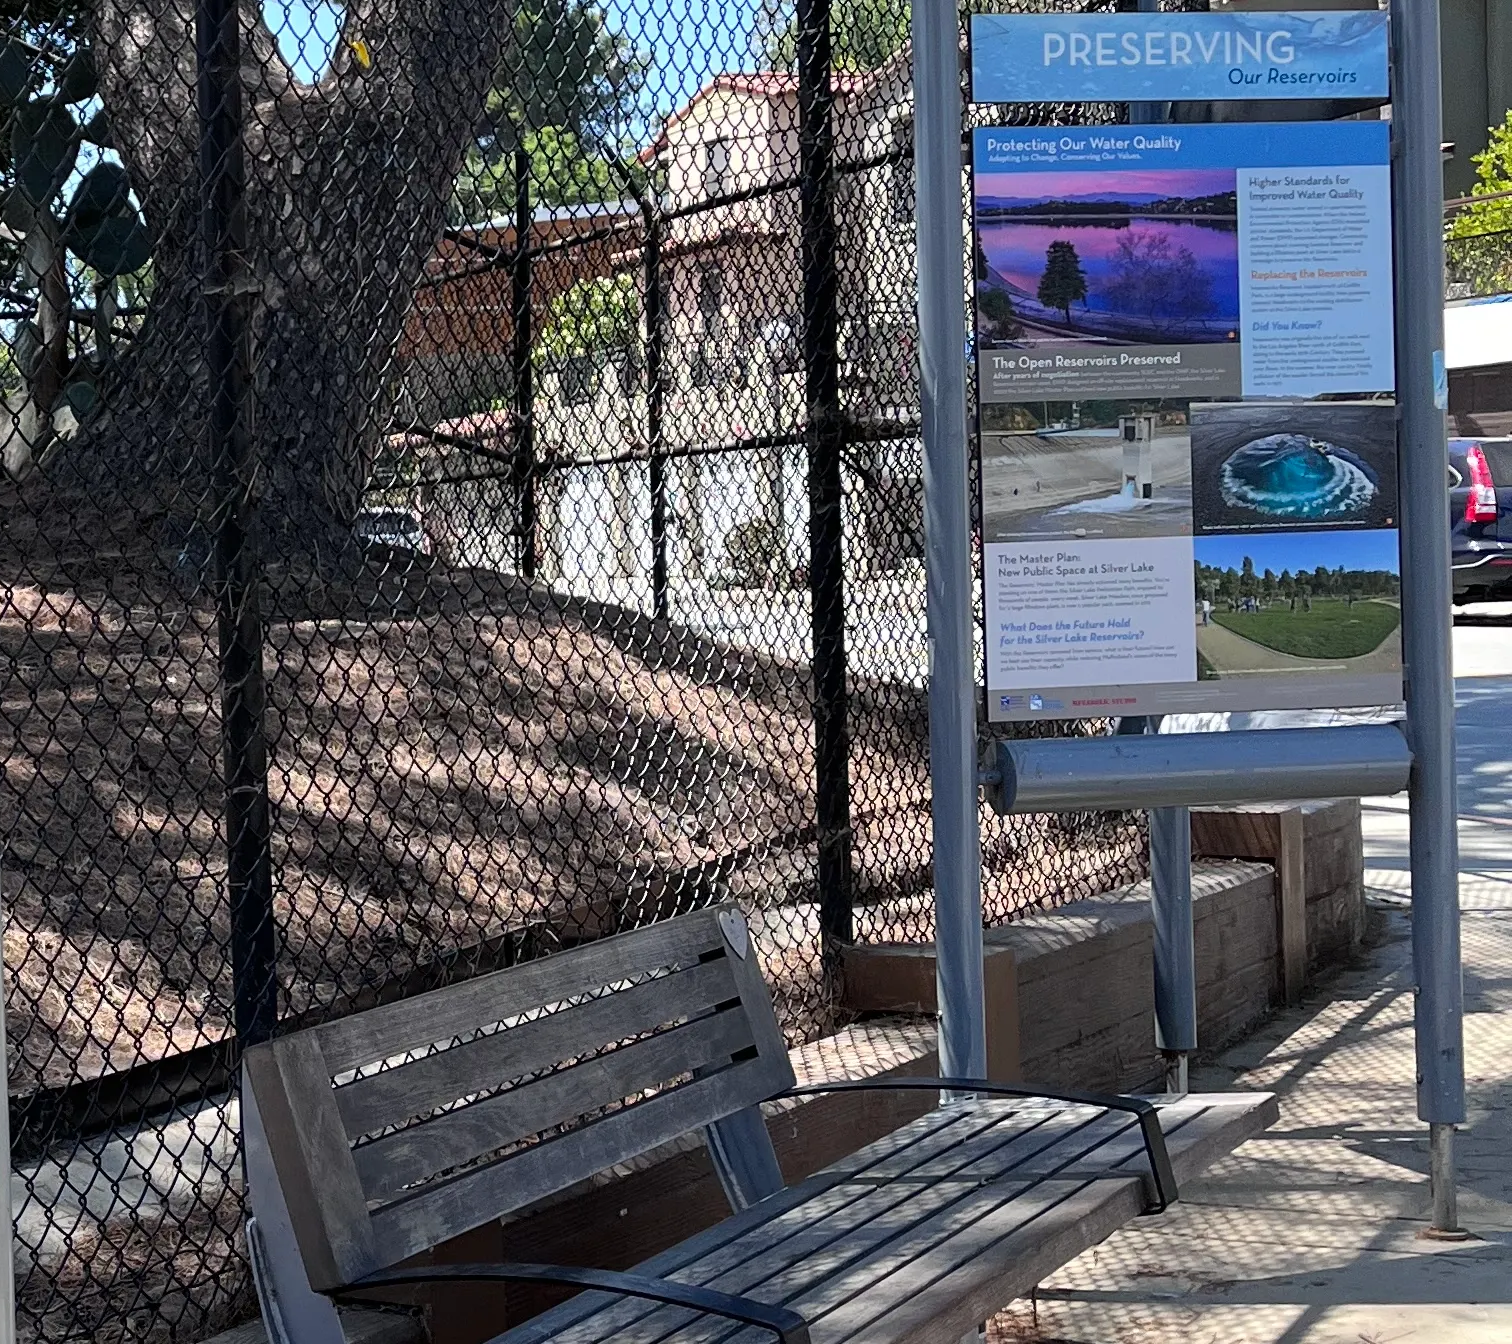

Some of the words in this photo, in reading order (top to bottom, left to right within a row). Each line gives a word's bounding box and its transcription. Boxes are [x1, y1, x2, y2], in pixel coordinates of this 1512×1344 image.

[1043, 30, 1296, 67] PRESERVING
[1228, 68, 1262, 84] Our
[1268, 68, 1356, 84] Reservoirs
[988, 138, 1056, 155] Protecting
[1060, 137, 1086, 154] Our
[1089, 137, 1130, 153] Water
[1133, 135, 1181, 151] Quality
[1249, 177, 1281, 189] Higher
[1284, 175, 1333, 187] Standards
[1336, 174, 1350, 184] for
[1249, 190, 1294, 202] Improved
[1297, 190, 1326, 200] Water
[1328, 189, 1364, 200] Quality
[992, 356, 1015, 369] The
[1018, 356, 1052, 369] Open
[1056, 355, 1117, 367] Reservoirs
[1119, 352, 1181, 365] Preserved
[997, 555, 1016, 564] The
[1020, 554, 1054, 563] Master
[1056, 552, 1080, 561] Plan:
[998, 568, 1020, 577] New
[1023, 566, 1053, 576] Public
[1056, 565, 1085, 577] Space
[1088, 565, 1098, 573] at
[1101, 563, 1128, 573] Silver
[1131, 562, 1154, 572] Lake
[1000, 622, 1026, 631] What
[1029, 622, 1052, 631] Does
[1055, 621, 1070, 631] the
[1073, 619, 1104, 629] Future
[1107, 618, 1131, 627] Hold
[1000, 635, 1014, 648] for
[1017, 635, 1032, 644] the
[1035, 634, 1062, 643] Silver
[1064, 633, 1087, 642] Lake
[1088, 630, 1144, 641] Reservoirs?
